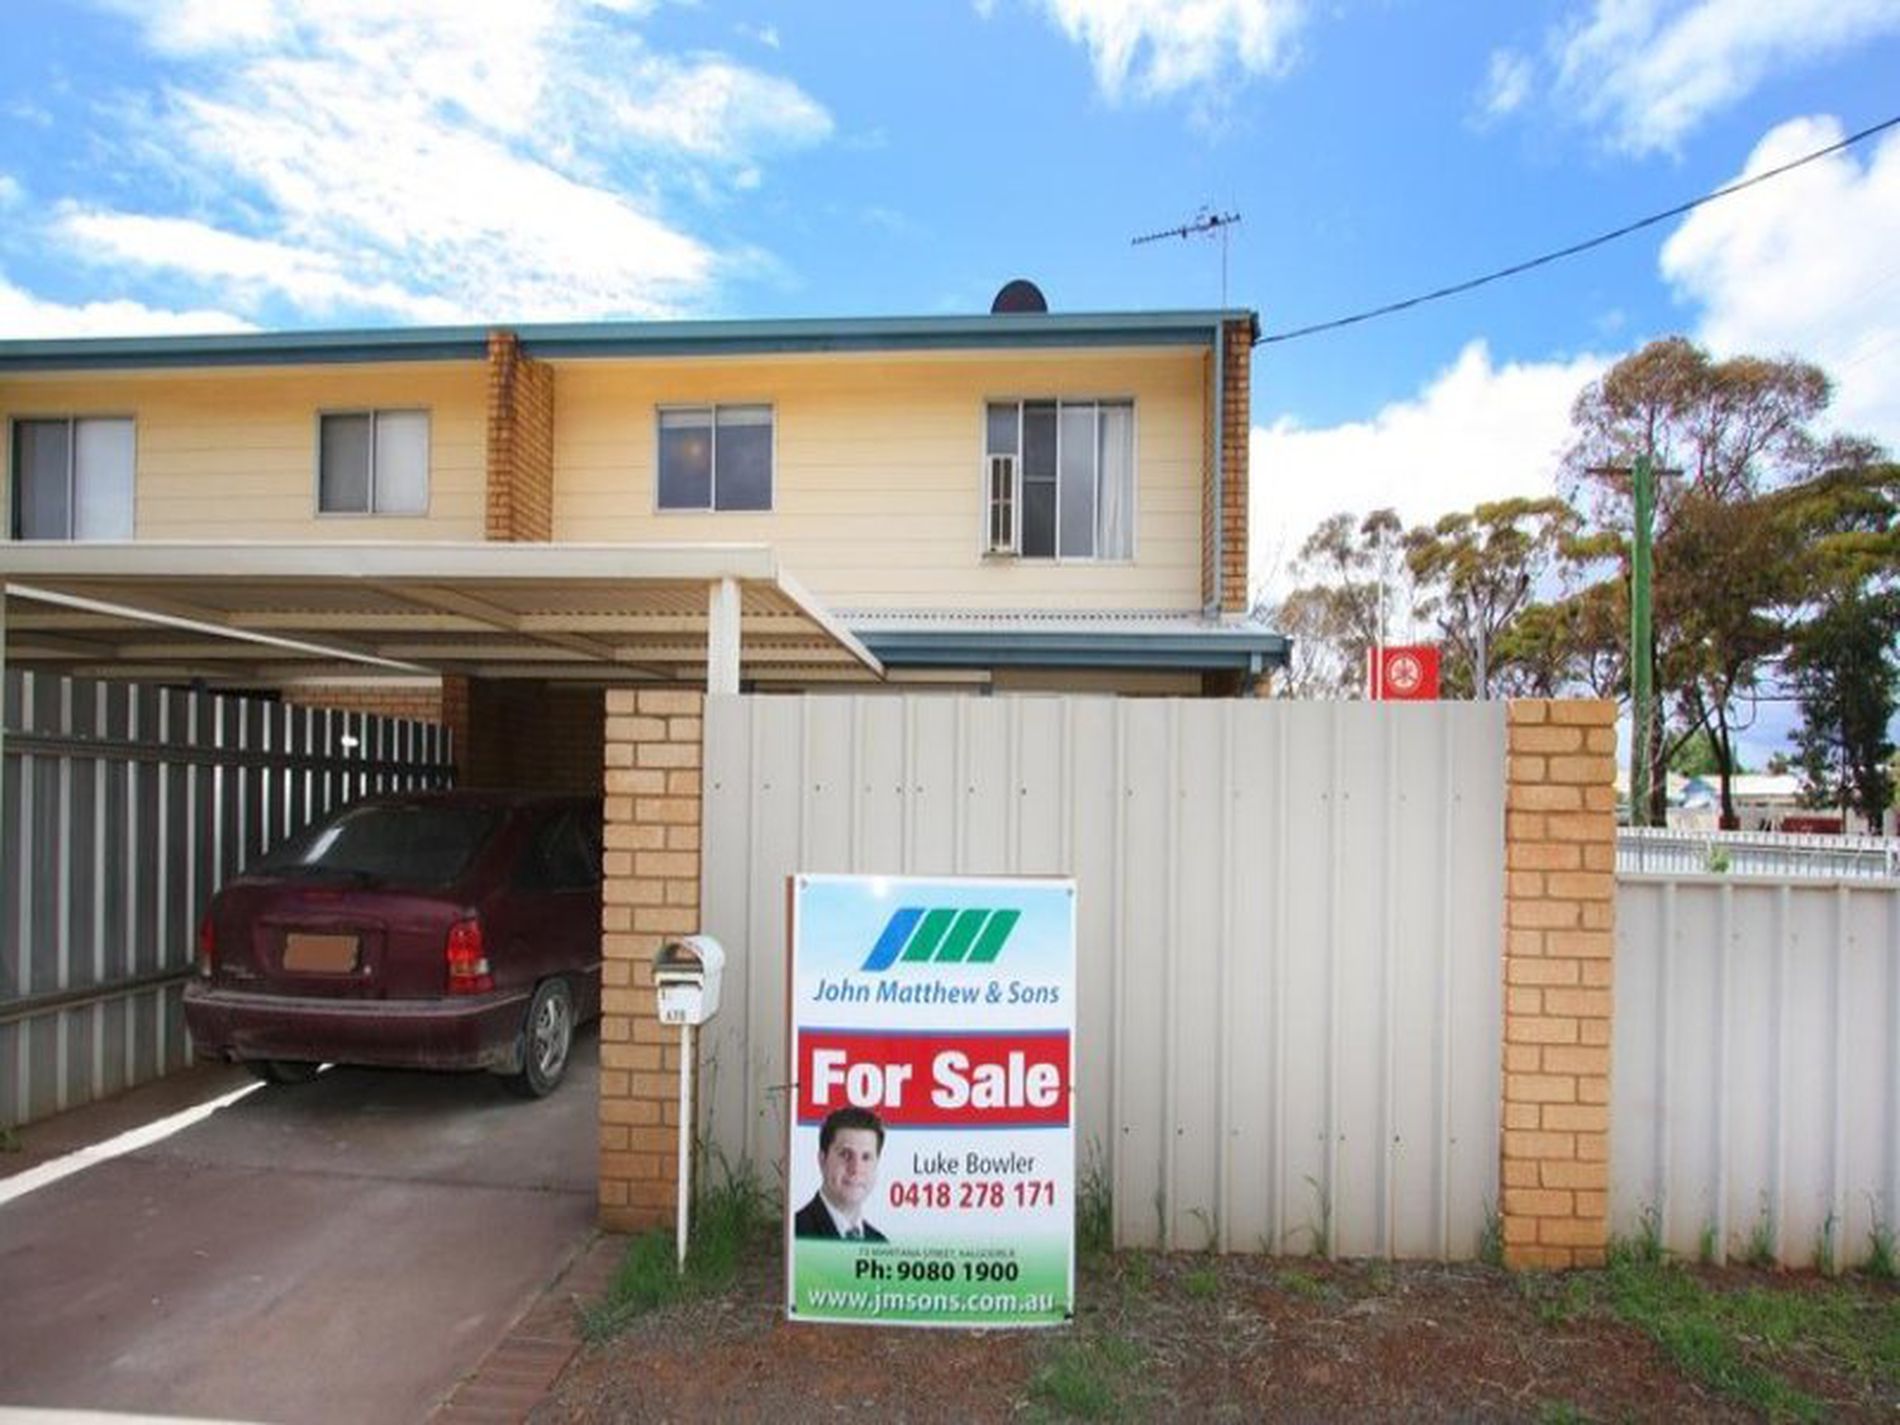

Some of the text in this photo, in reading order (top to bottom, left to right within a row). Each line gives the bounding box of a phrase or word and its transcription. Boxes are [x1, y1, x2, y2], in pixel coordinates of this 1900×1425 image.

[813, 979, 1060, 1003] John Matthew & Sons
[811, 1048, 1060, 1108] For Sale
[913, 1152, 1034, 1175] Luke Bowler
[890, 1181, 1055, 1208] 0418 278 171
[856, 1258, 1018, 1282] Ph: 9080 1900
[807, 1286, 1054, 1313] www.jmsons.com.au
